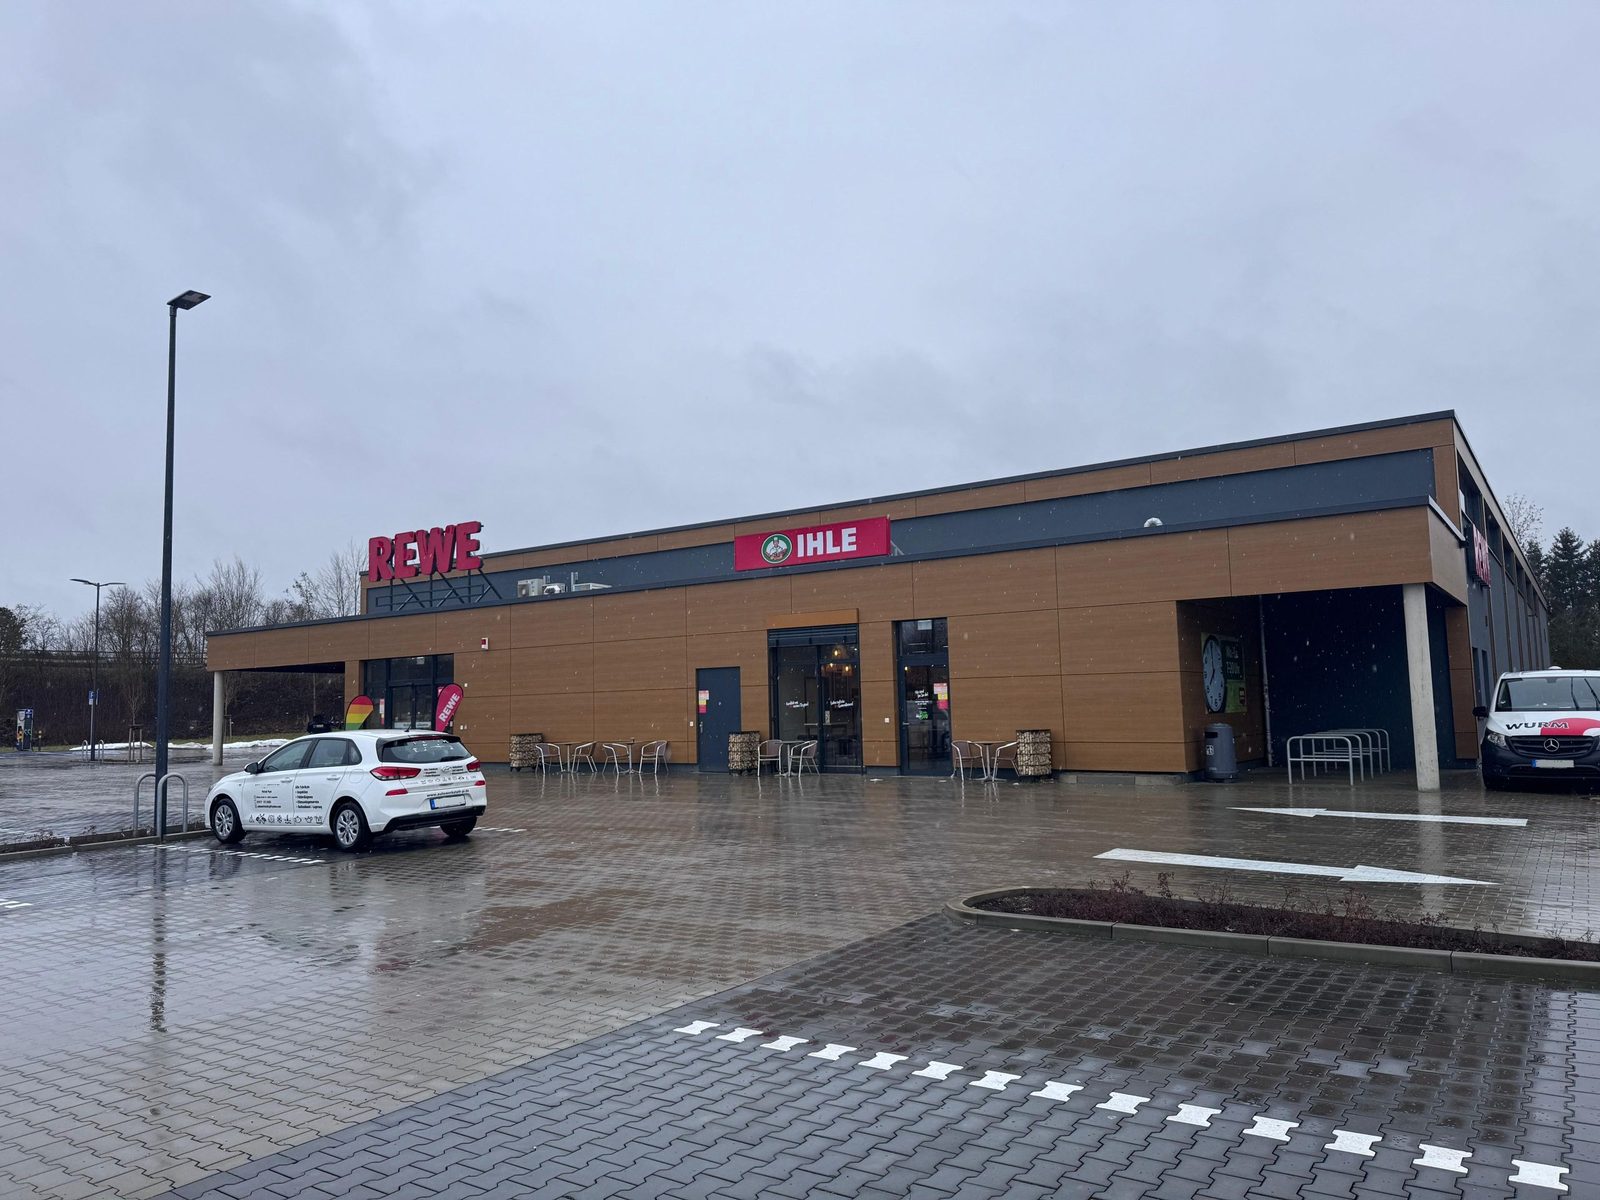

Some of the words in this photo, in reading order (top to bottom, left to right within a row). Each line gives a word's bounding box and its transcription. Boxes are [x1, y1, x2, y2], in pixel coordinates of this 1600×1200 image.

[369, 521, 482, 582] REWE
[797, 527, 857, 558] IHLE
[439, 693, 460, 723] REWE
[1505, 721, 1569, 731] WURM
